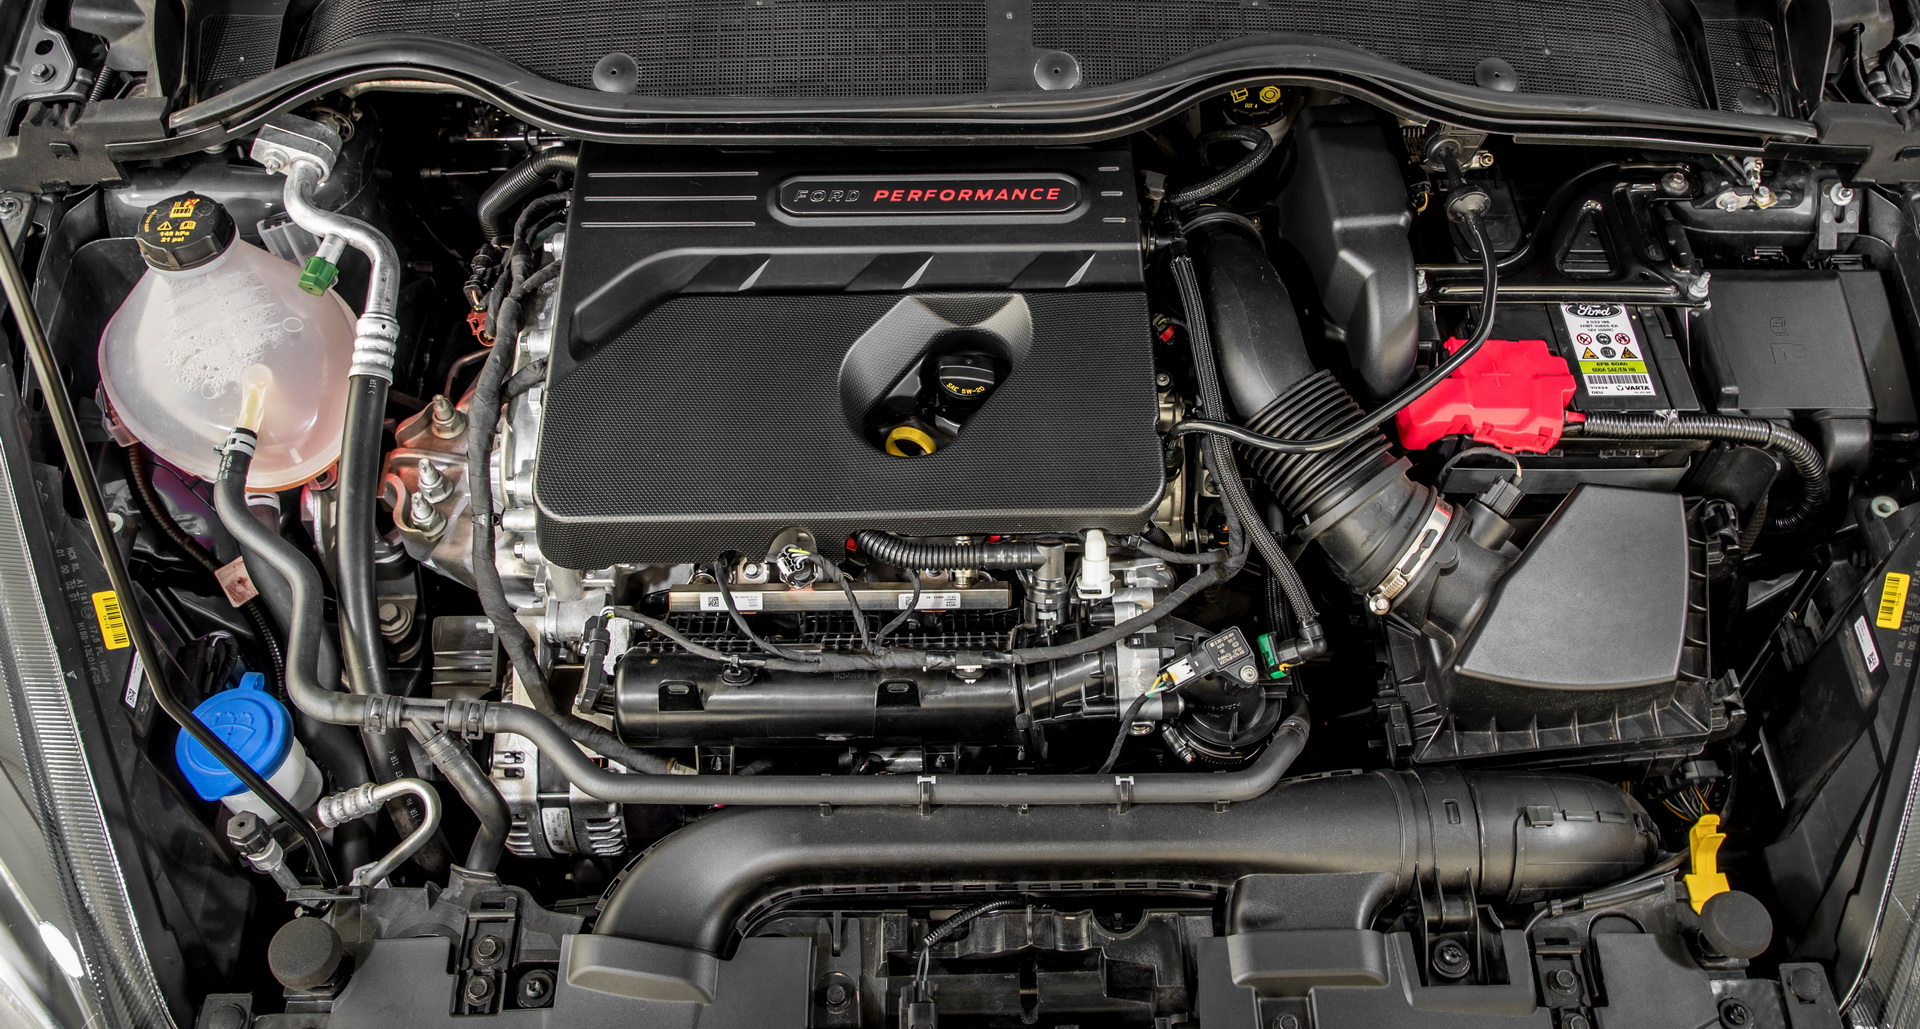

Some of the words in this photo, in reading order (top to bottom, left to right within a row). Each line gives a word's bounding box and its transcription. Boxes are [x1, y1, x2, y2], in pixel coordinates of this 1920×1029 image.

[793, 189, 861, 203] FORD
[873, 188, 1061, 202] PERFORMANCE
[1577, 303, 1611, 316] Ford
[946, 382, 960, 392] SAE
[961, 385, 985, 394] 5W-20
